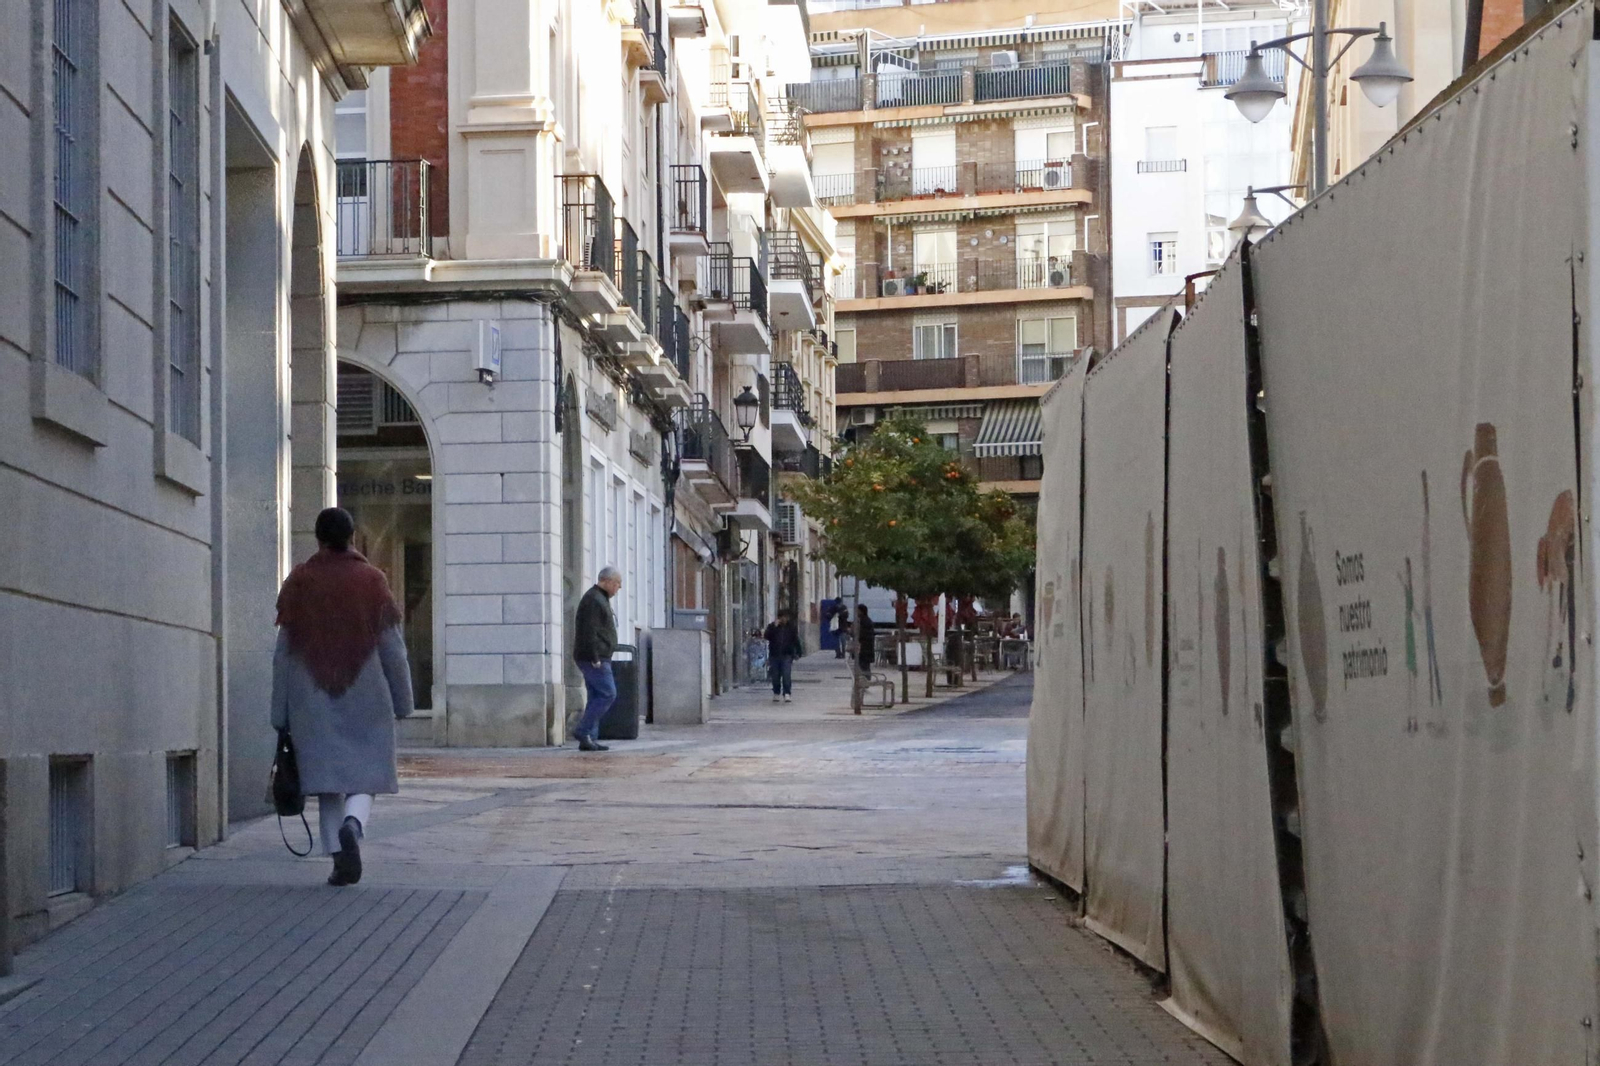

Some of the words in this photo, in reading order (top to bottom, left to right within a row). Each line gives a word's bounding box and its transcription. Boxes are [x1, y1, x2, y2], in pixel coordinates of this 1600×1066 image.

[1335, 549, 1365, 586] Somos
[1339, 594, 1372, 633] nuestro
[1342, 637, 1388, 691] patrimonio
